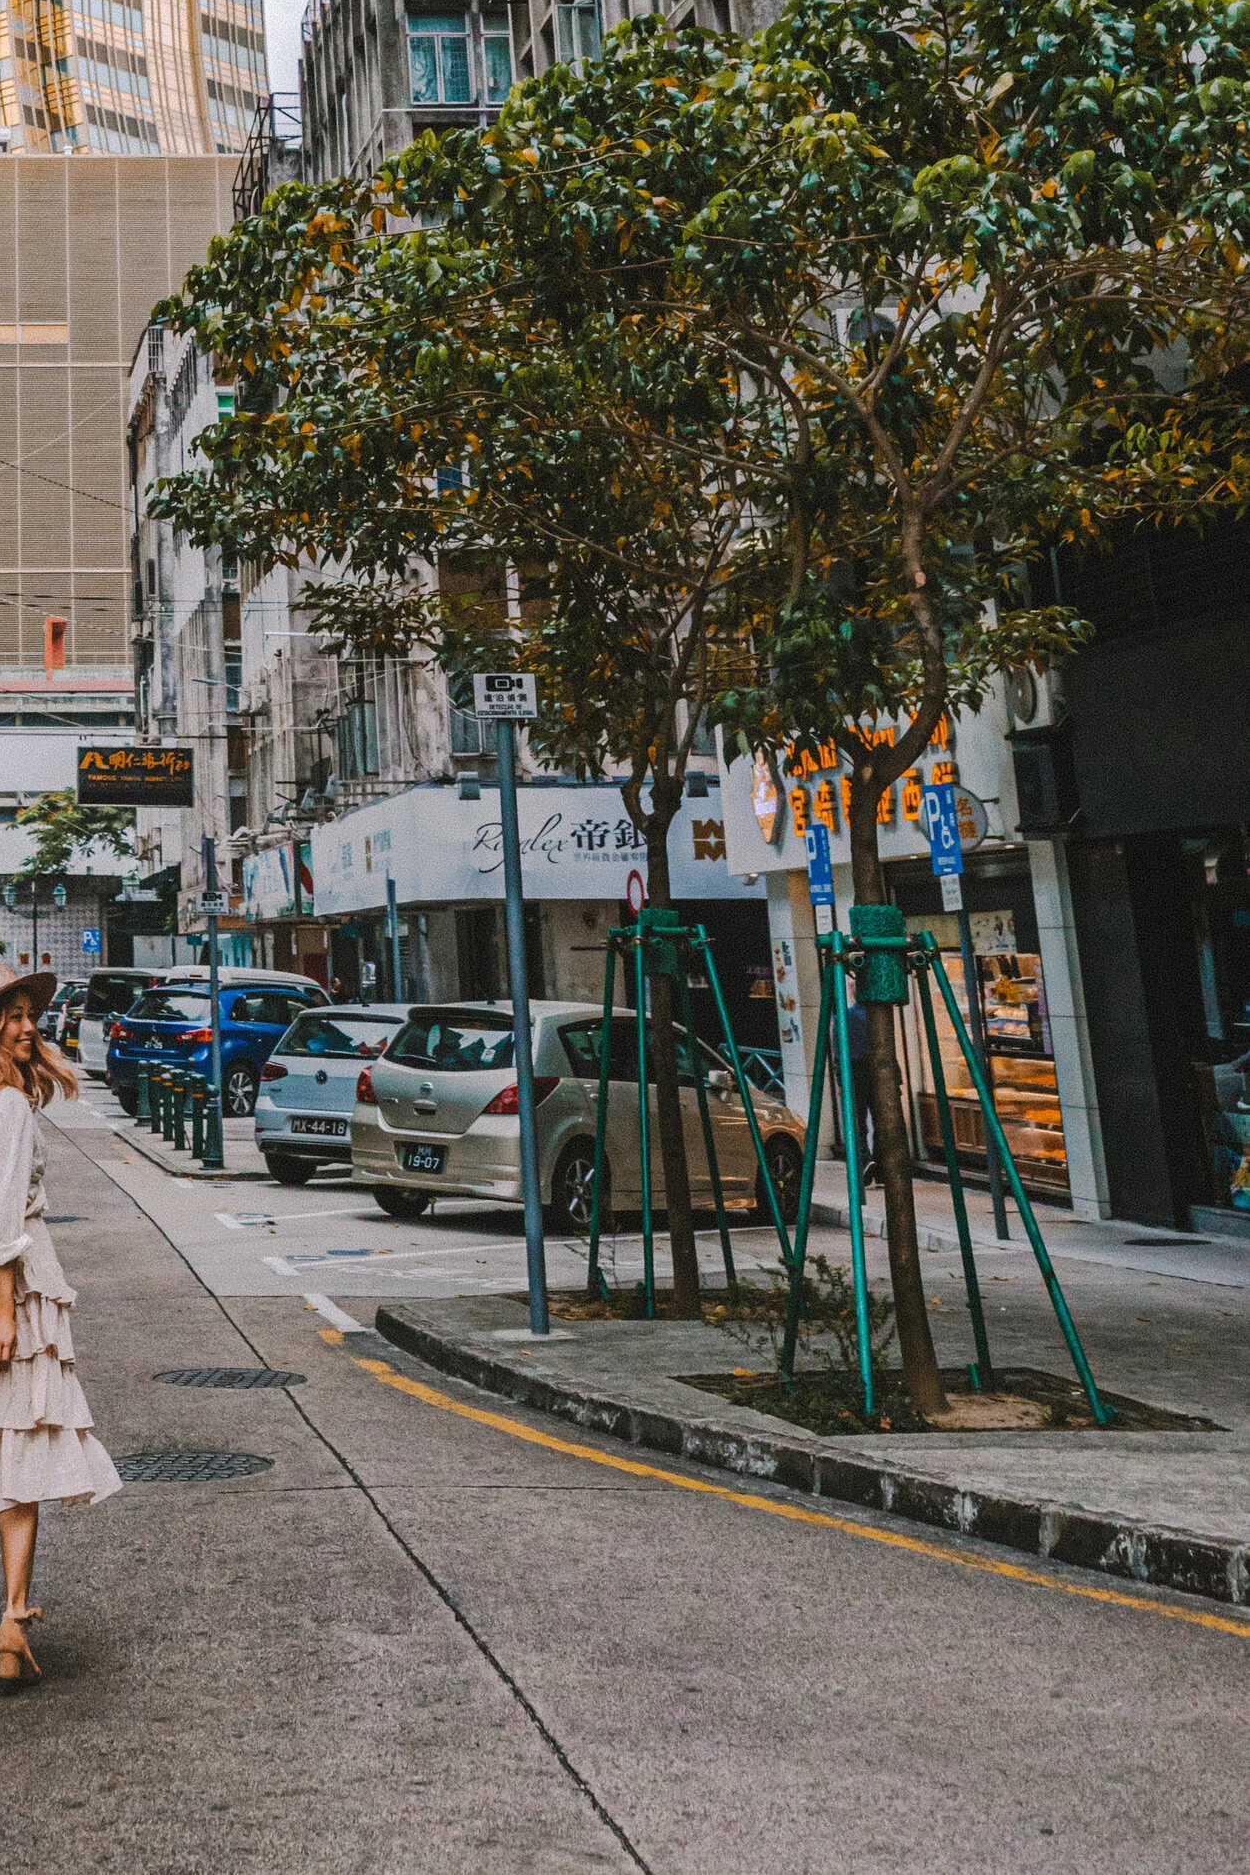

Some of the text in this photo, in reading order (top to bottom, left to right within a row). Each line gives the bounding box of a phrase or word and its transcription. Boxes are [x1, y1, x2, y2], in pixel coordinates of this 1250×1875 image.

[925, 792, 941, 842] P
[292, 1120, 346, 1135] MX-44-18
[407, 1155, 440, 1169] 19-07
